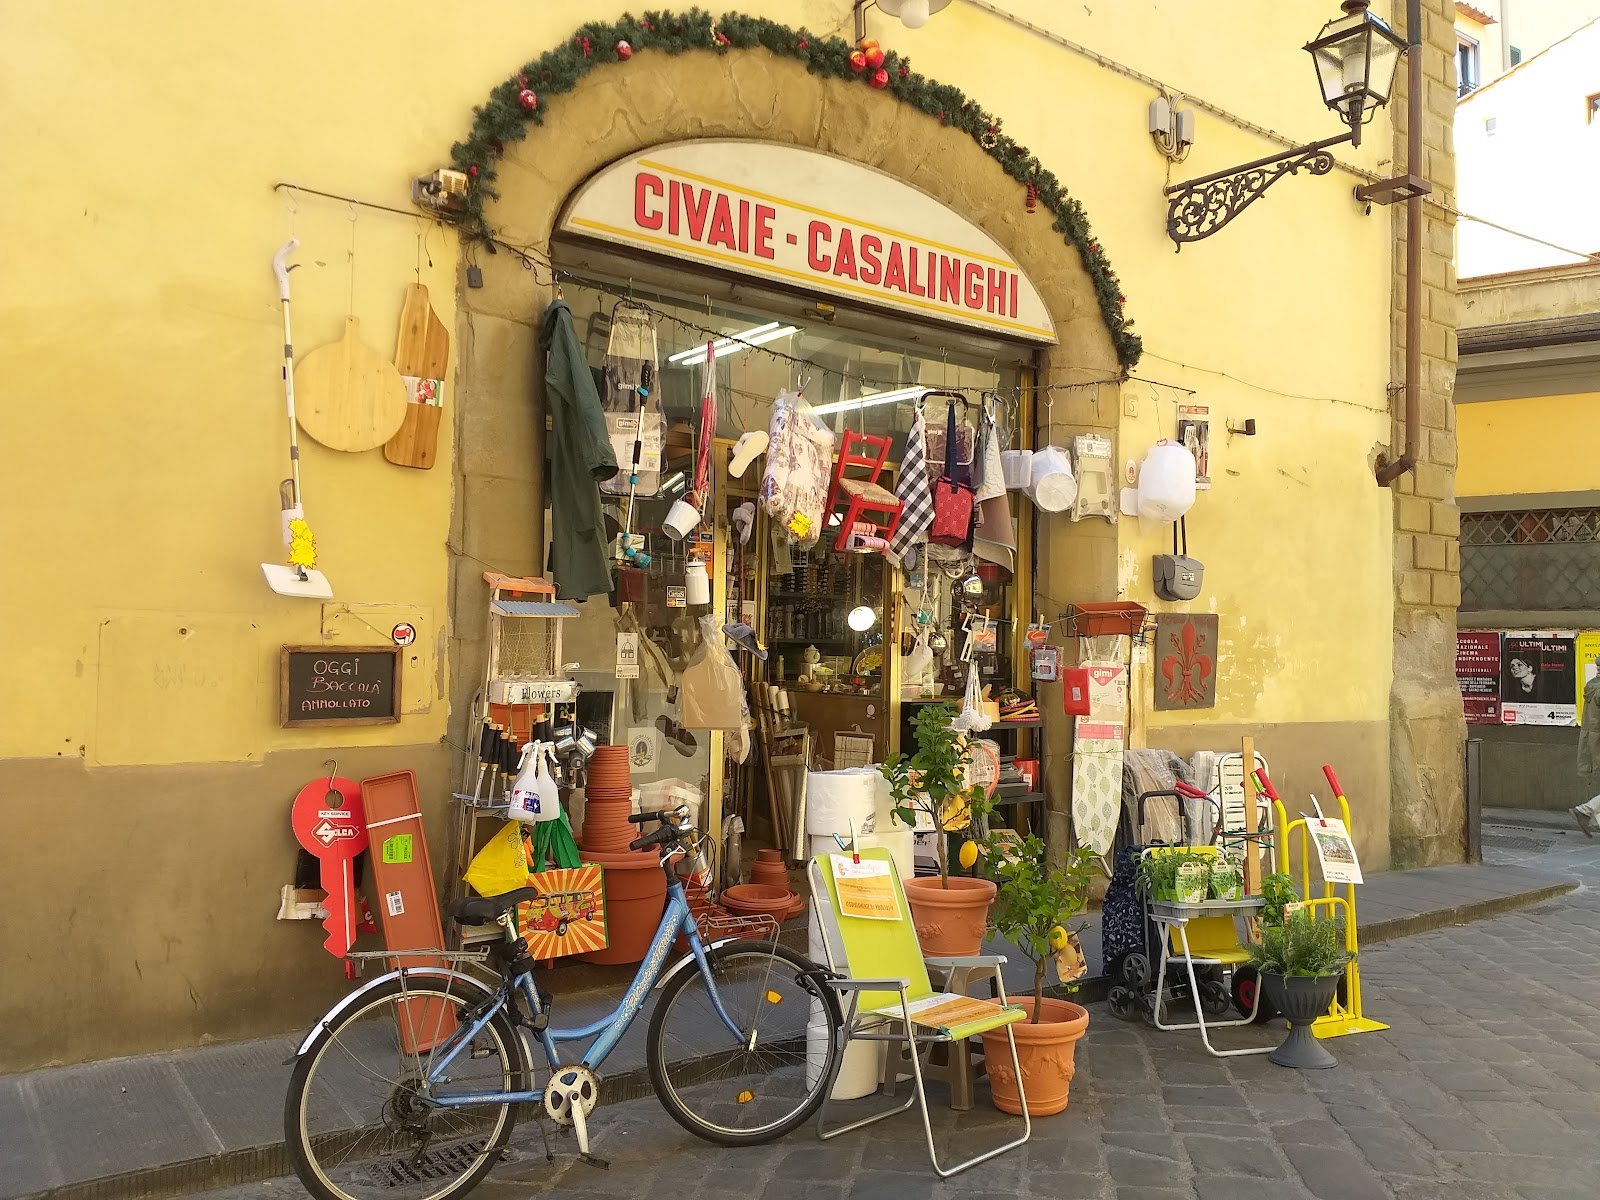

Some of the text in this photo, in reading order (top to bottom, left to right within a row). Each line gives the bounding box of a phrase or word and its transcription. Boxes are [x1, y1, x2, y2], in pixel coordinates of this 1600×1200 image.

[634, 172, 775, 260] CIVAIE
[807, 220, 1019, 319] CASALINGHI
[1093, 668, 1113, 678] gimi
[521, 687, 561, 700] Flowers
[301, 699, 371, 711] AMMOLLATO
[1547, 711, 1556, 720] 4
